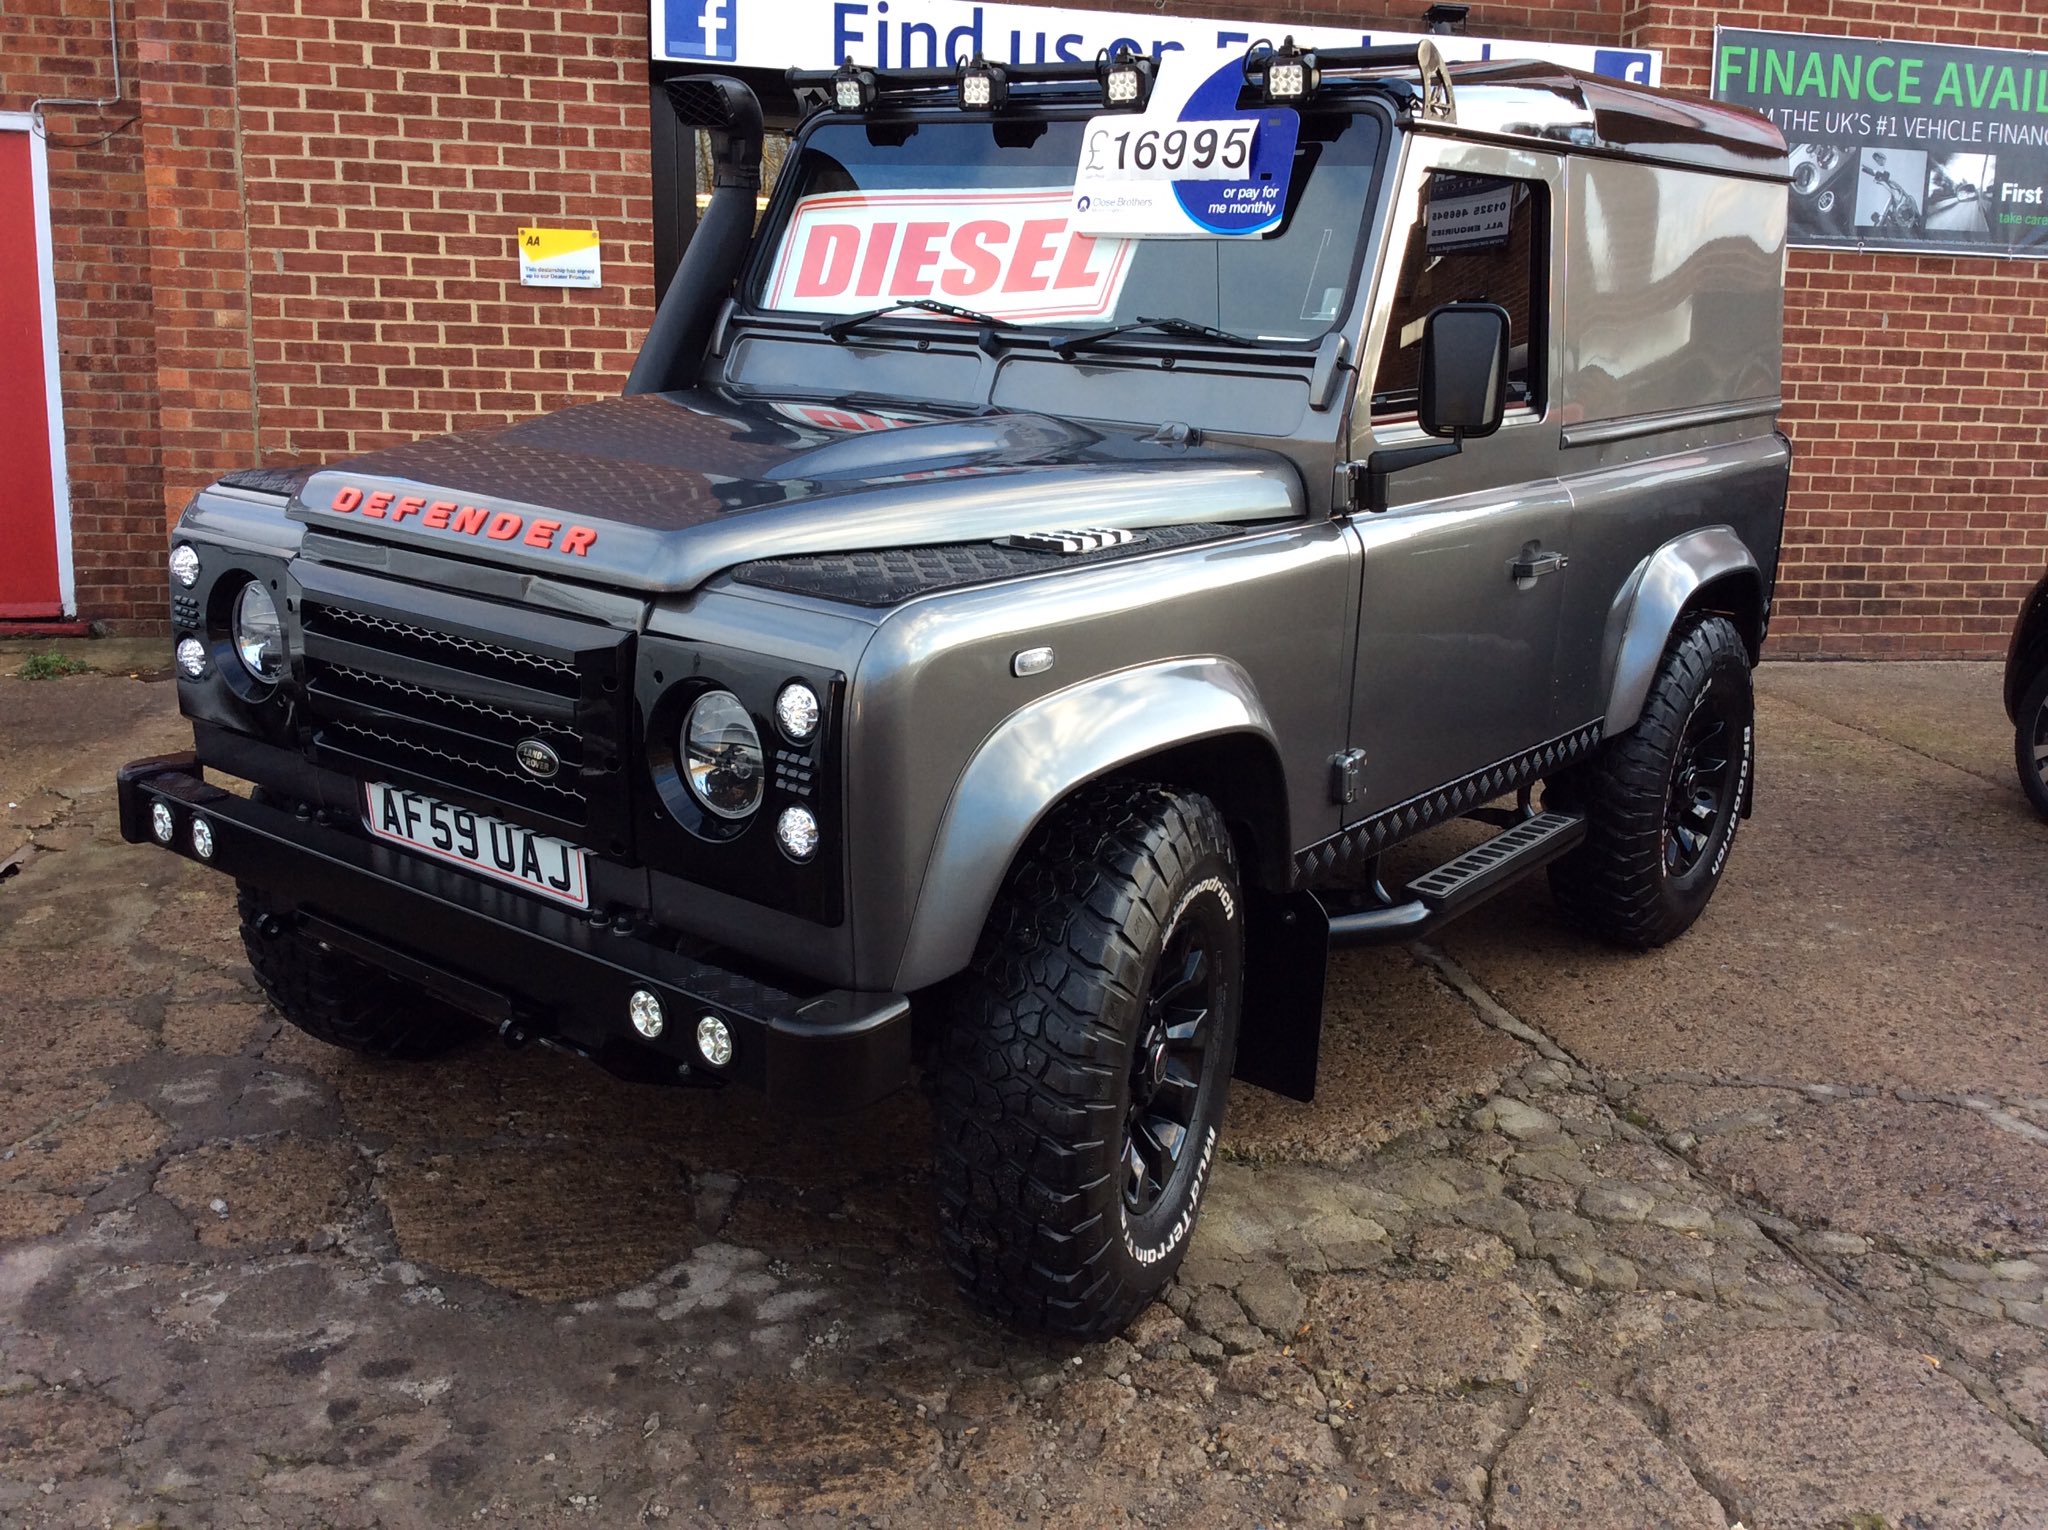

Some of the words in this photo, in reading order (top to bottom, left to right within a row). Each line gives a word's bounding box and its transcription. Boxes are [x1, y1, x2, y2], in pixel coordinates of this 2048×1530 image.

[833, 1, 983, 69] Find
[1011, 30, 1084, 64] us
[1719, 45, 1924, 104] FINANCE
[1780, 108, 1820, 132] THE
[1825, 111, 1872, 135] UK'S
[1876, 115, 1898, 138] #1
[1903, 116, 1983, 142] VEHICLE
[1988, 122, 2048, 146] FINAN
[1092, 197, 1115, 207] Close
[1117, 197, 1152, 207] Brothers
[1223, 187, 1237, 198] or
[1237, 187, 1260, 201] pay
[1262, 185, 1279, 198] for
[2001, 182, 2043, 204] First
[1208, 203, 1227, 214] me
[1228, 201, 1276, 217] monthly
[1999, 213, 2023, 225] take
[526, 235, 540, 247] AA
[794, 218, 1103, 298] DIESEL
[331, 486, 597, 557] DEFENDER
[383, 787, 479, 860] AF59
[490, 821, 571, 892] UAJ
